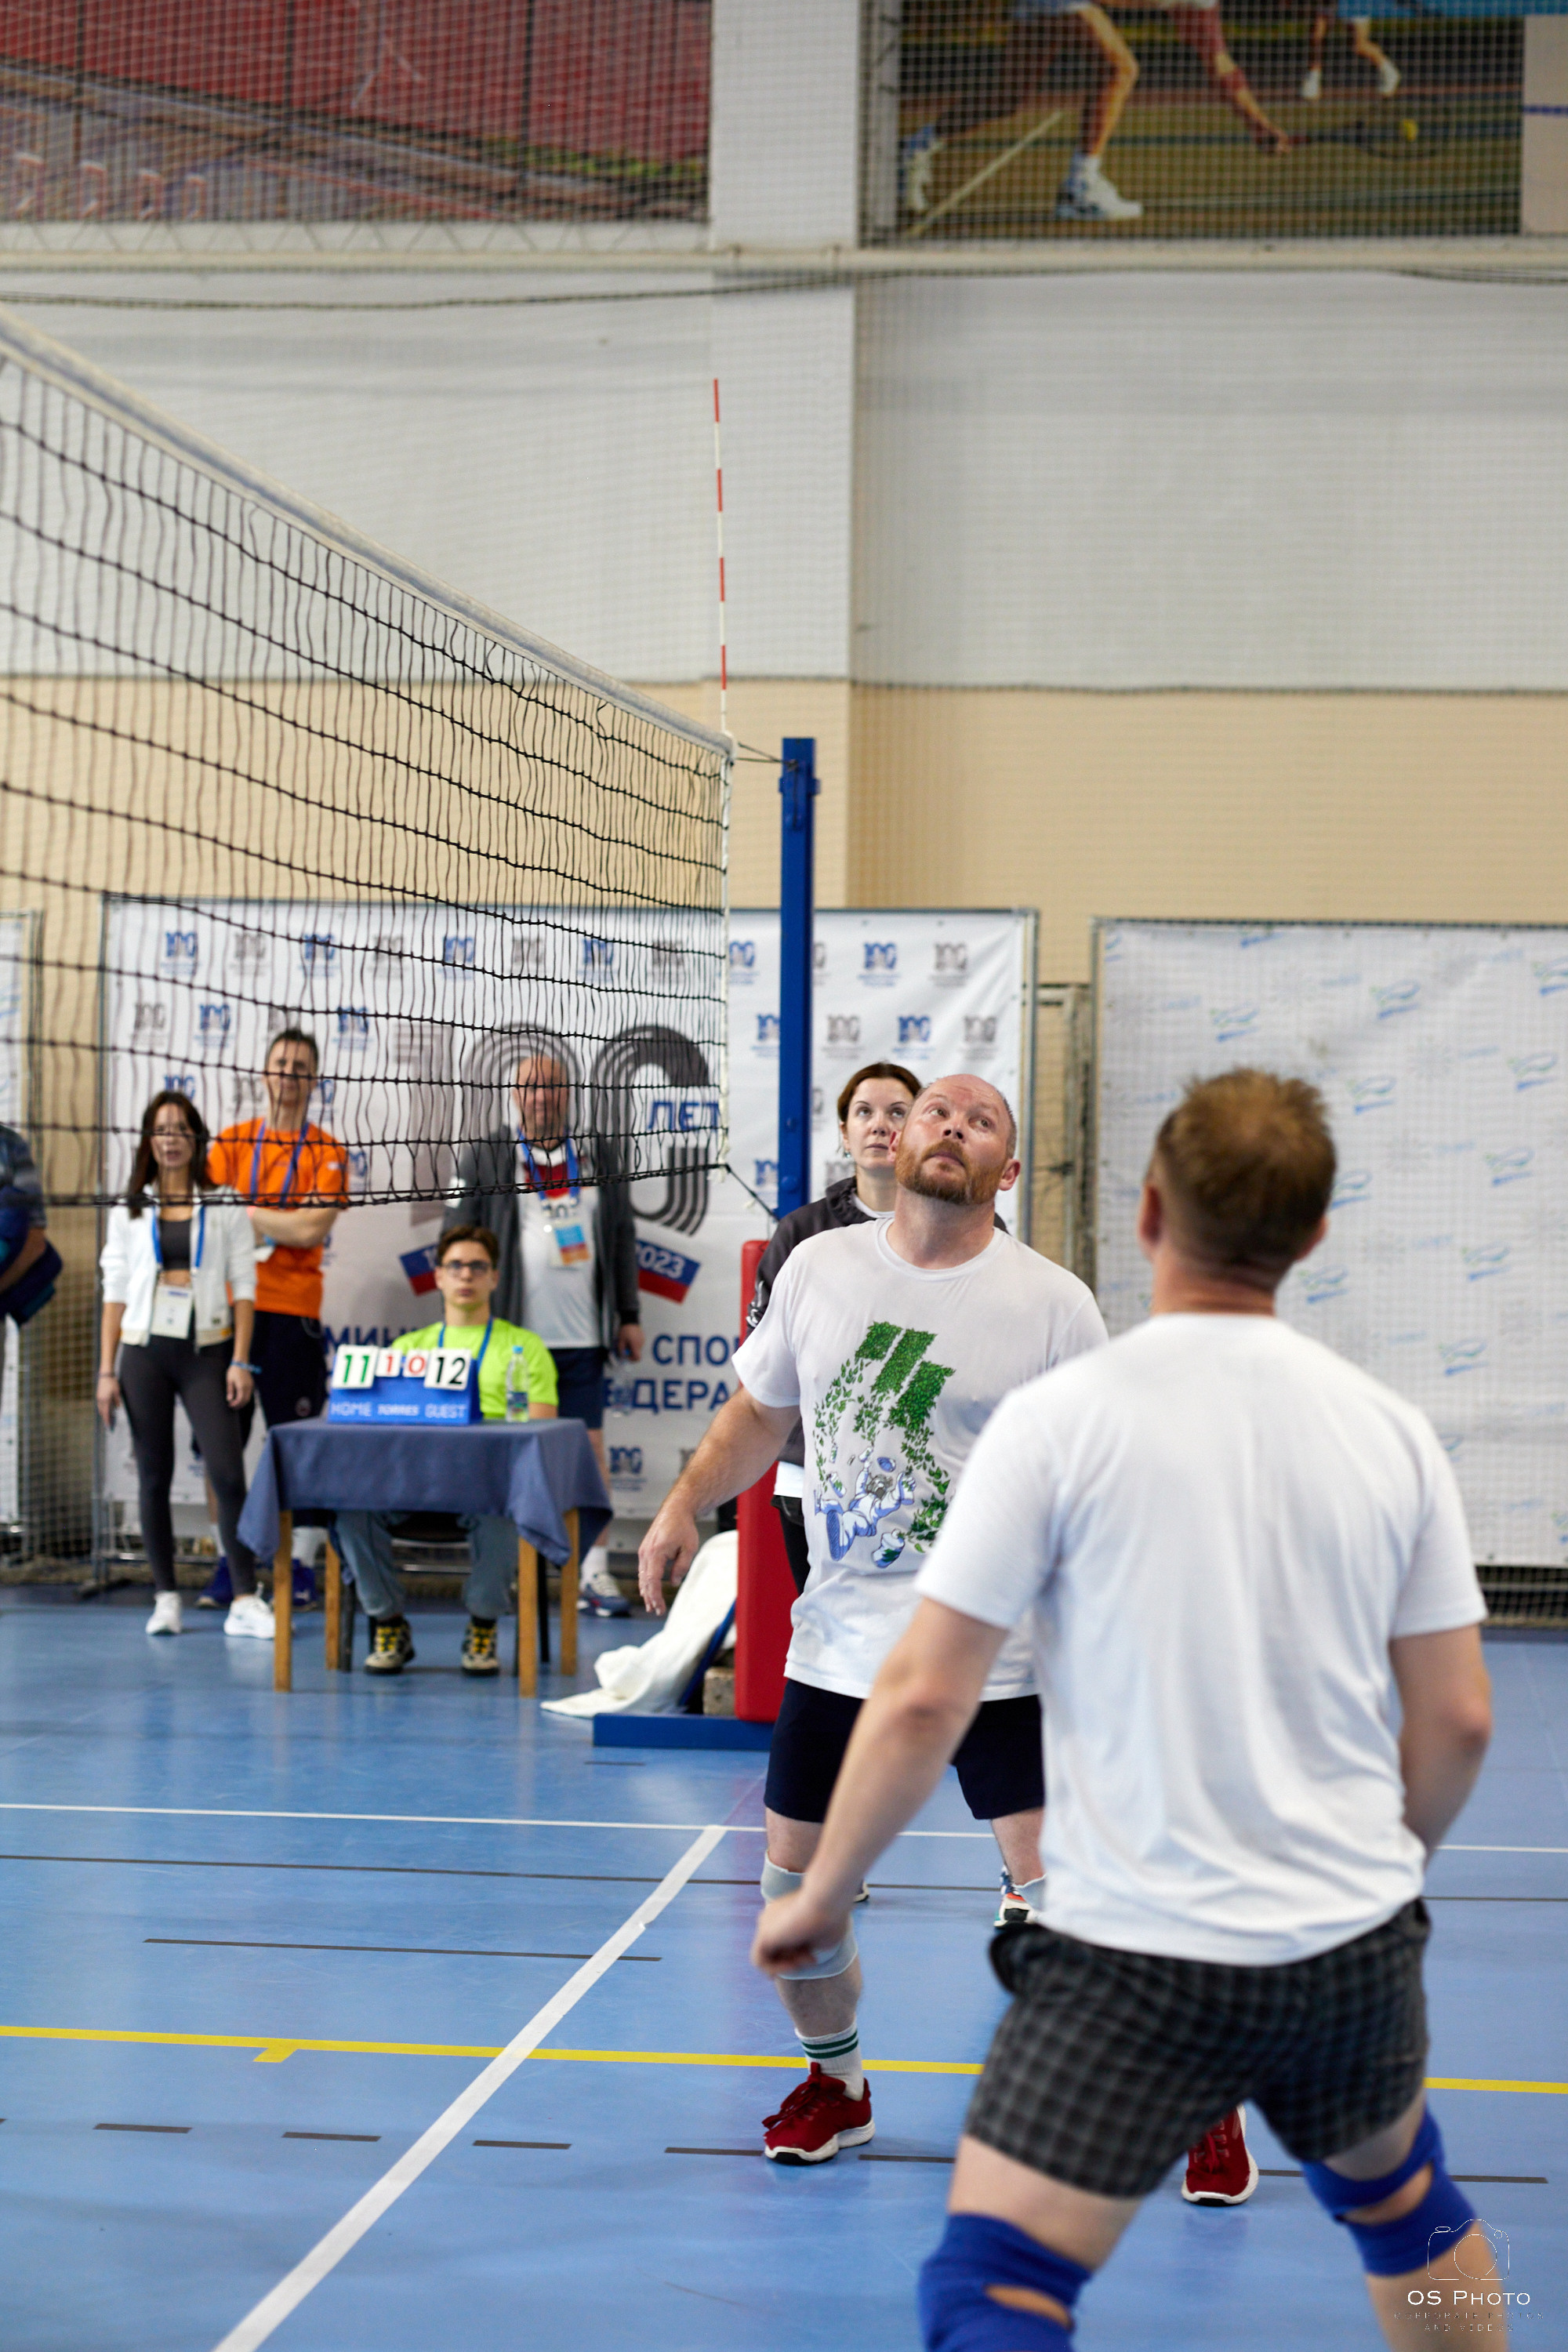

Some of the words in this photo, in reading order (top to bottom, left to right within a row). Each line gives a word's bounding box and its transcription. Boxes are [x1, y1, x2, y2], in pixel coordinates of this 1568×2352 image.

[652, 1334, 739, 1365] СПО
[343, 1354, 370, 1383] 11
[435, 1356, 466, 1385] 12
[330, 1400, 372, 1417] HOME
[424, 1403, 466, 1418] GUEST
